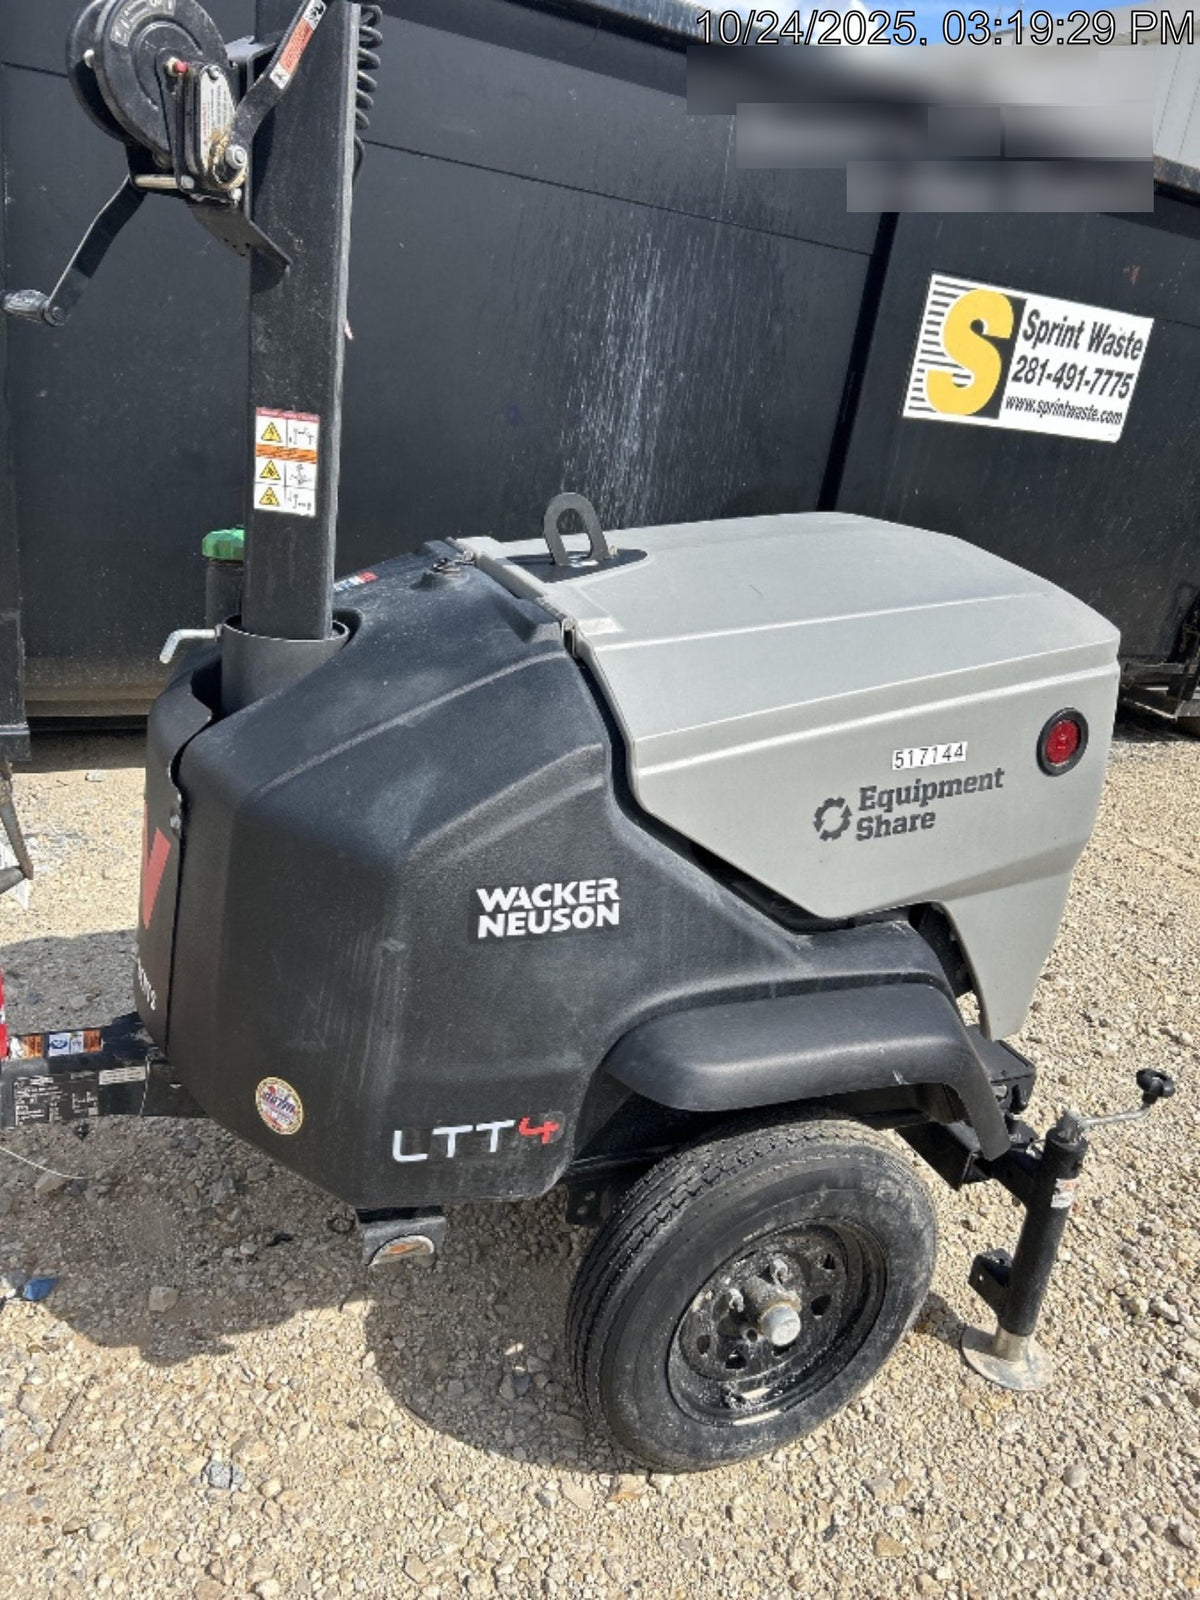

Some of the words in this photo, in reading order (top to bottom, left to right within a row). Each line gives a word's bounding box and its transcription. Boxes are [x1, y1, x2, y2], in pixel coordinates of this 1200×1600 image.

[926, 289, 1014, 416] S
[1022, 309, 1085, 350] Sprint
[1087, 321, 1144, 361] Waste
[1011, 355, 1134, 399] 281-491-7775
[1005, 395, 1123, 425] www.sprintwaste.com
[894, 743, 964, 769] 517144
[858, 767, 1006, 813] Equipment
[856, 811, 937, 841] Share
[476, 878, 621, 912] WACKER
[477, 902, 620, 938] NEUSON
[392, 1116, 560, 1163] LTT4
